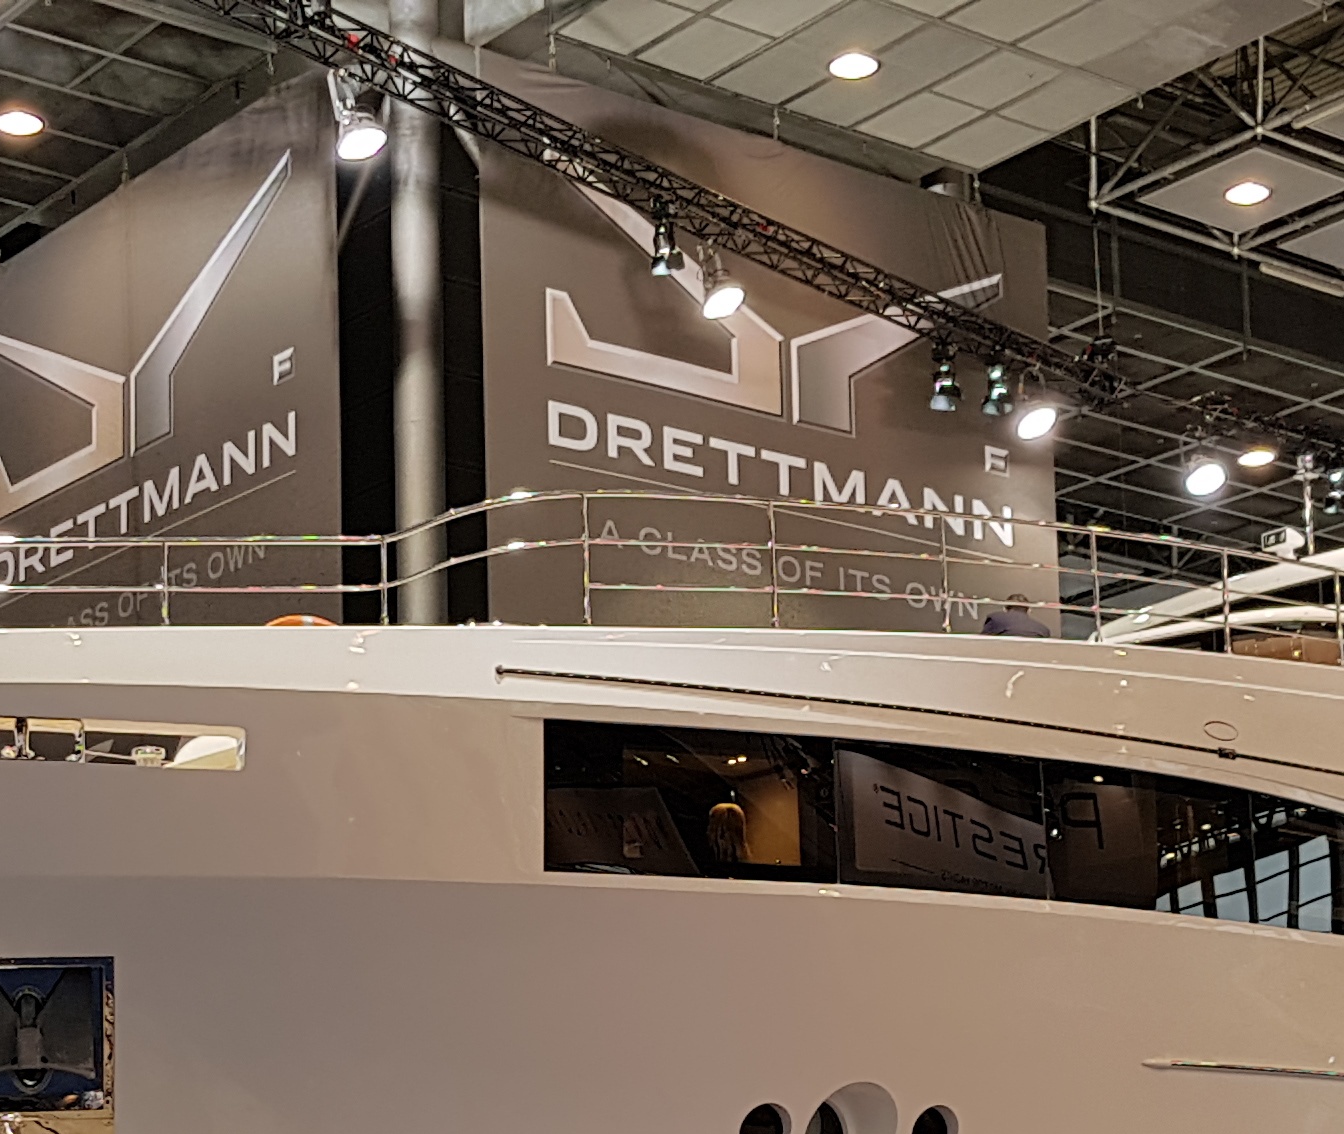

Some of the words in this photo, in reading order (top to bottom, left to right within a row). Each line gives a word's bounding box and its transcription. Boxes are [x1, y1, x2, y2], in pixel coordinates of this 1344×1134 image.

[547, 399, 1016, 548] DRETTMANN
[600, 519, 623, 543] A
[637, 526, 763, 577] CLASS
[777, 555, 825, 586] OF
[838, 566, 892, 595] ITS
[904, 581, 981, 620] OWN
